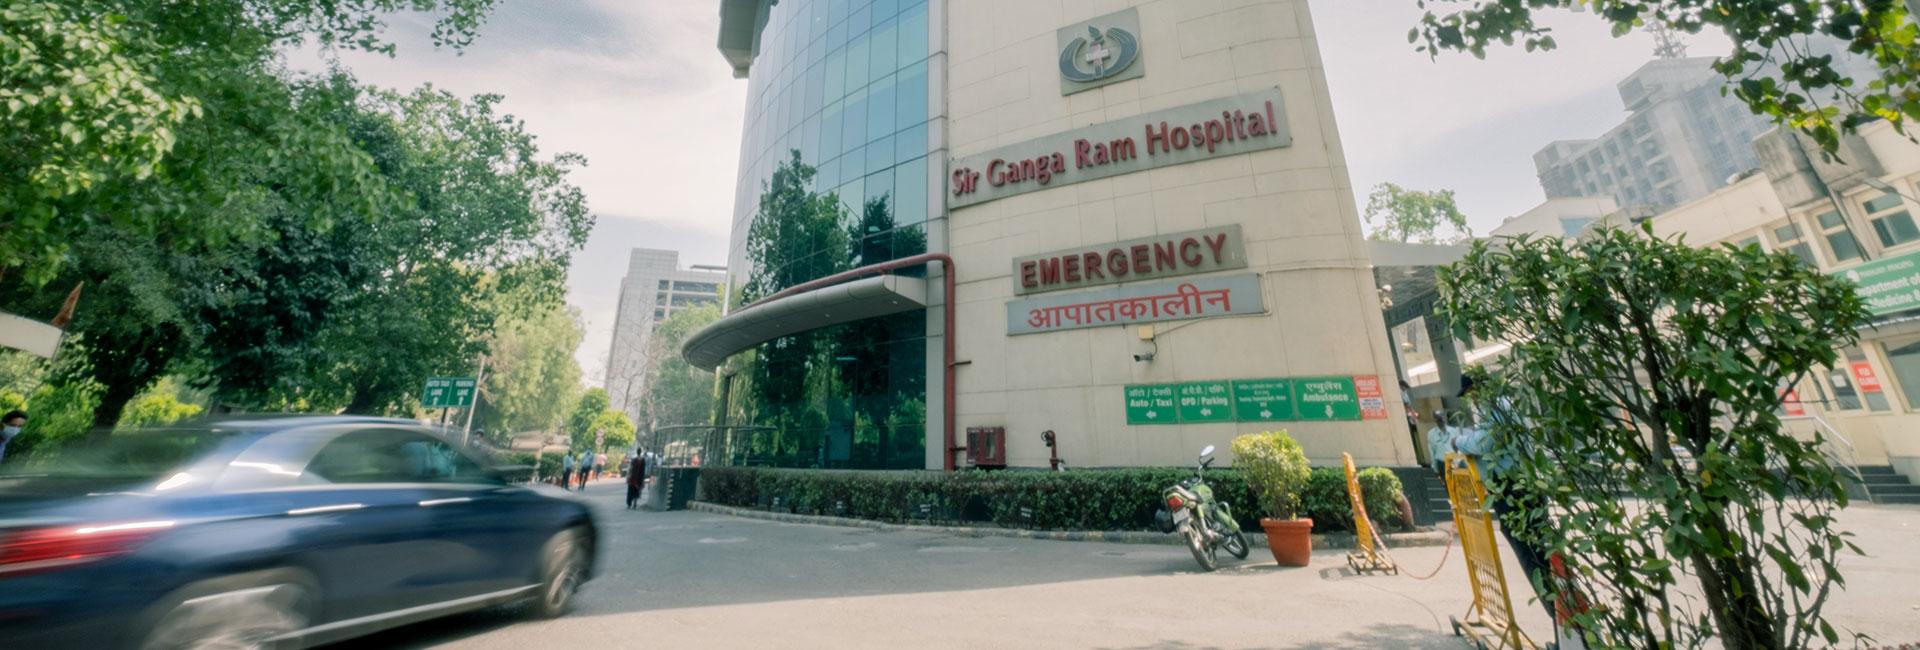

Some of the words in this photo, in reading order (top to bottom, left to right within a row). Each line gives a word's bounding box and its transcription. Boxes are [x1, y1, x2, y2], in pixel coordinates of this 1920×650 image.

[952, 166, 979, 196] Sir
[986, 151, 1065, 186] Ganga
[1074, 136, 1137, 170] Ram
[1145, 99, 1277, 155] Hospital
[1020, 233, 1226, 288] EMERGENCY
[1028, 283, 1231, 328] आपातकालीन
[1129, 399, 1149, 407] Auto
[1155, 398, 1173, 407] Taxi
[1181, 397, 1196, 406] OPD
[1201, 397, 1228, 406] Parking
[1303, 393, 1349, 402] Ambulance
